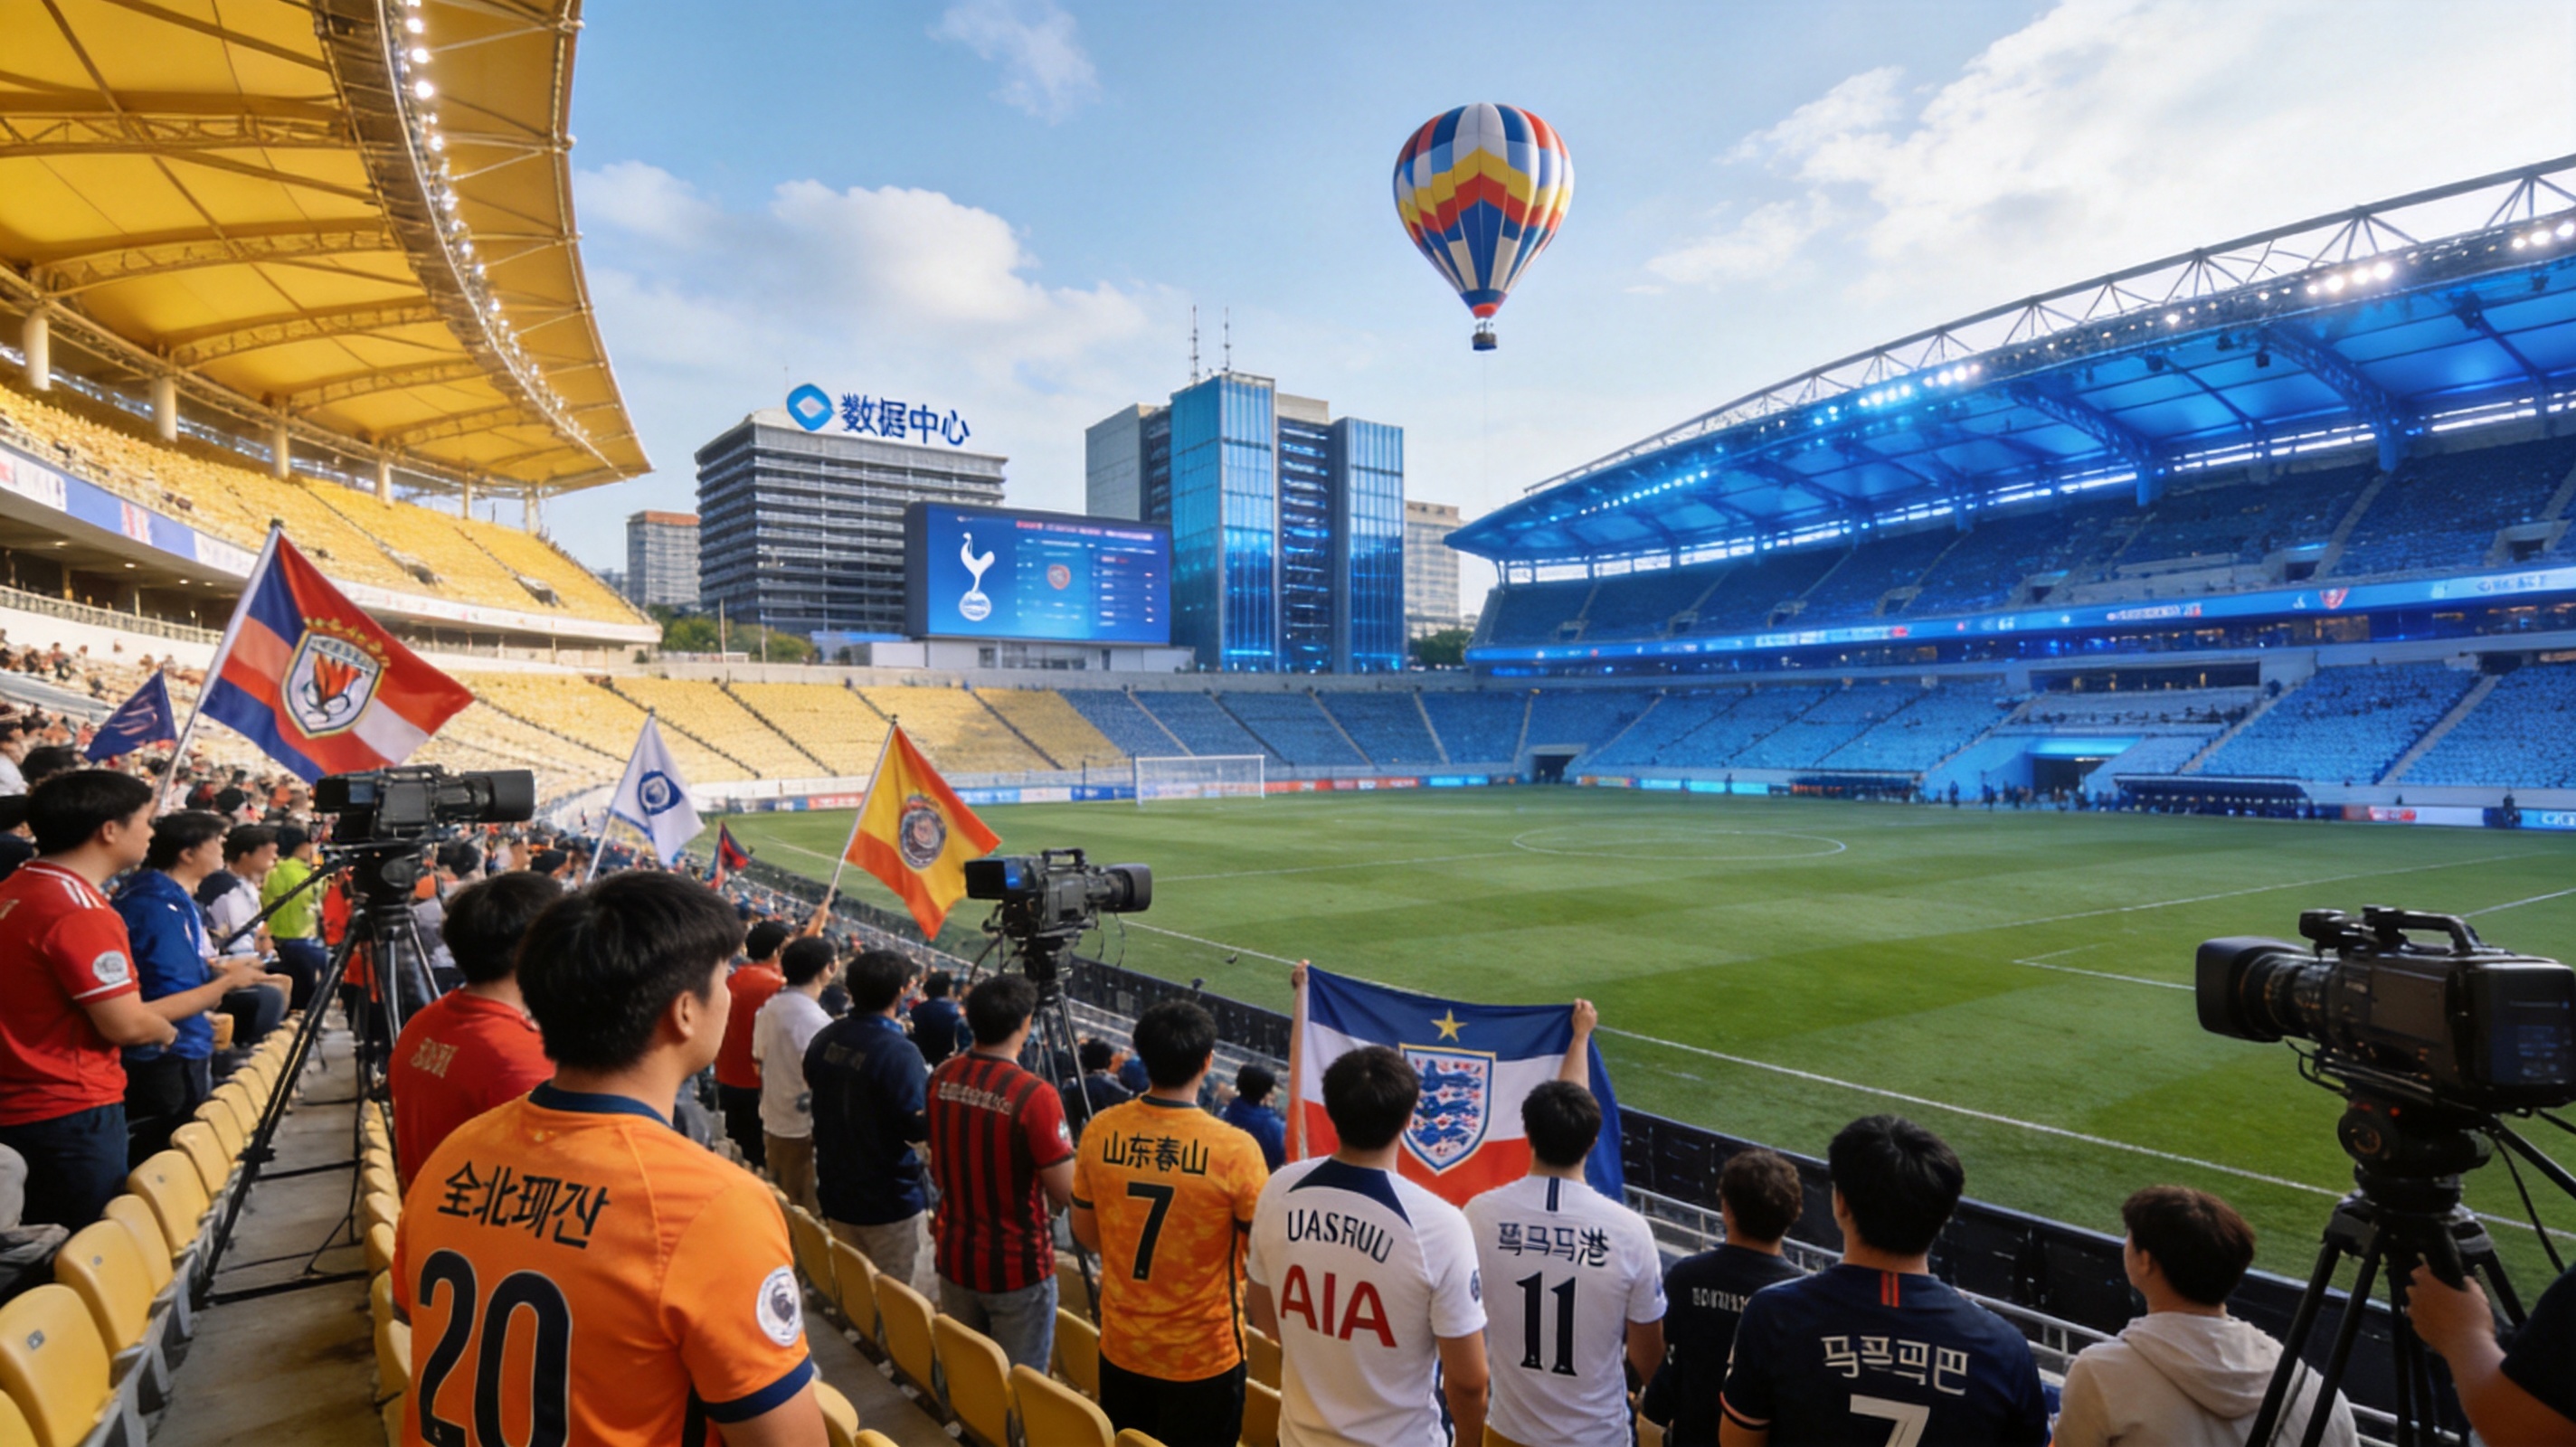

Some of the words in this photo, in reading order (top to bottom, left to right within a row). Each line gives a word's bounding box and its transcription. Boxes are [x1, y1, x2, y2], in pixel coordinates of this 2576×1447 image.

[840, 392, 971, 446] 数据中心
[1127, 1182, 1175, 1281] 7
[419, 1247, 573, 1447] 20
[1280, 1264, 1397, 1348] AIA
[1516, 1272, 1577, 1376] 11
